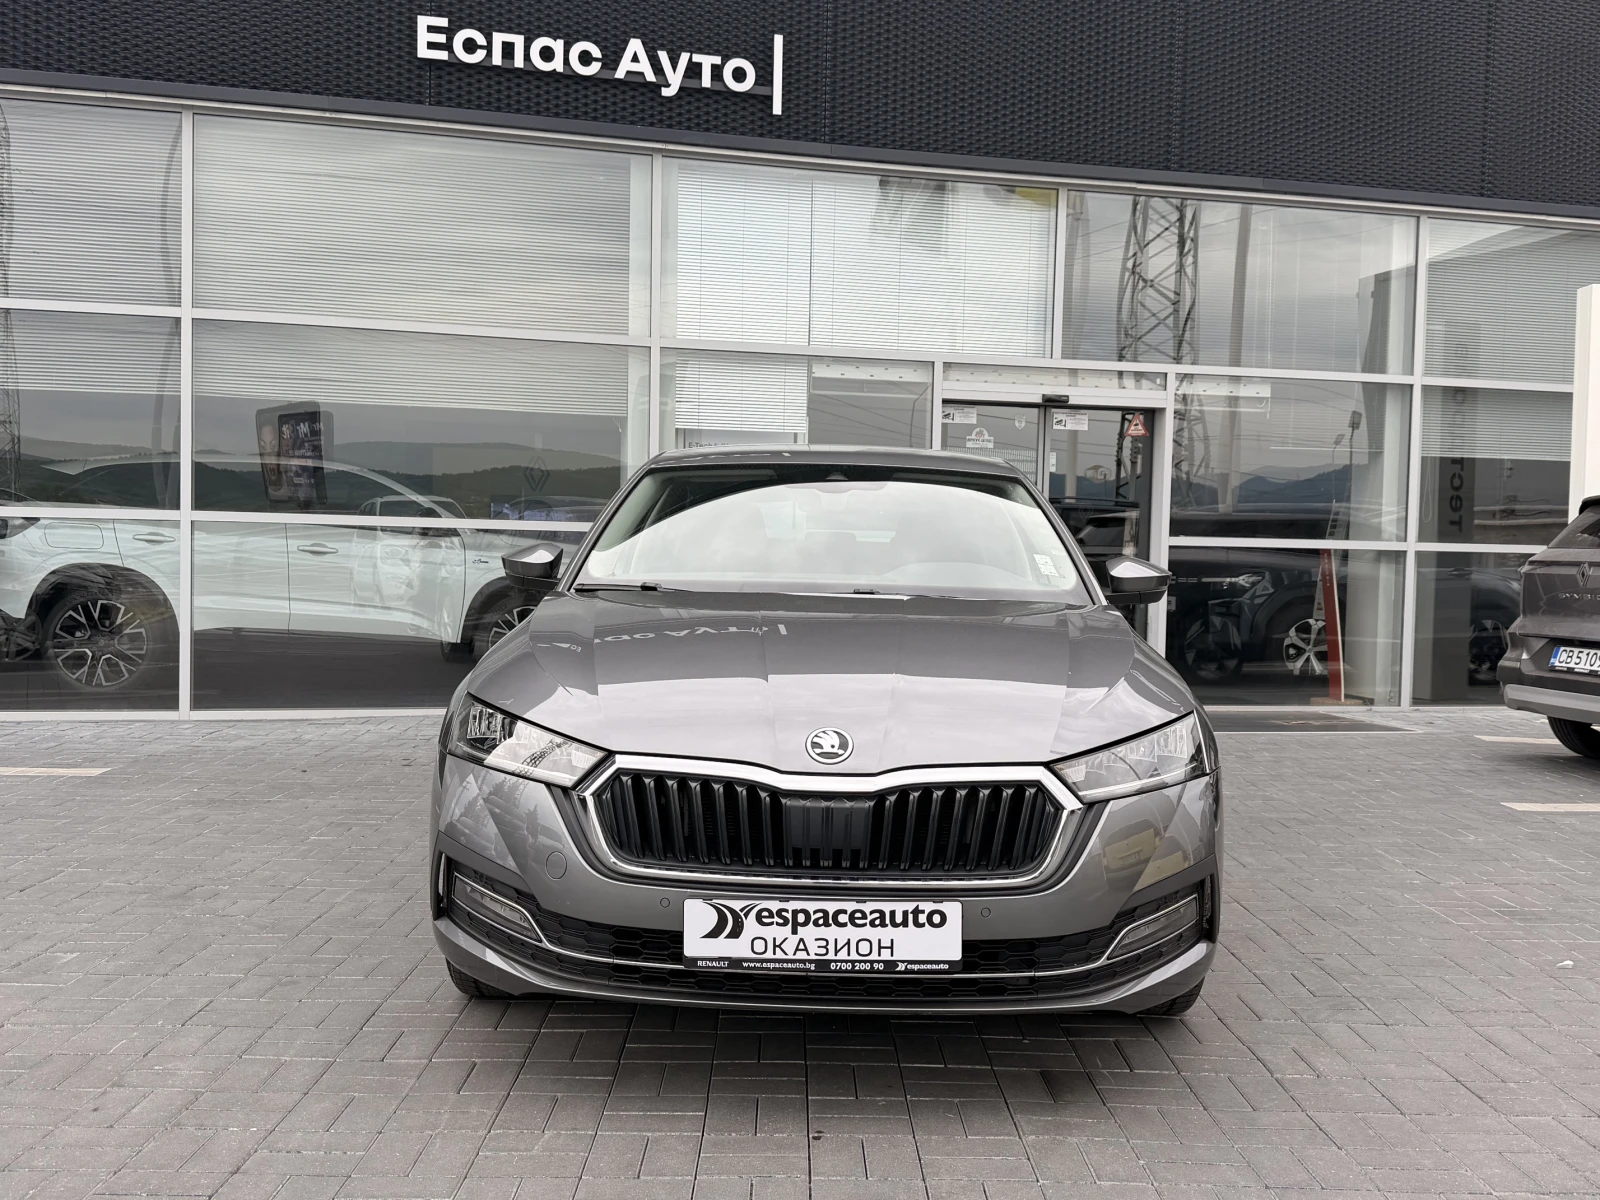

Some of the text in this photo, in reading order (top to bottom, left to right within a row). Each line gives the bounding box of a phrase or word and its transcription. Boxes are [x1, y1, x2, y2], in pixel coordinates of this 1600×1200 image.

[416, 14, 757, 97] Еспас Ауто
[754, 903, 948, 936] espaceauto
[750, 936, 895, 958] ОКАЗИОН
[742, 961, 816, 970] www.espaceauto.bg
[830, 962, 852, 970] 0700
[854, 962, 871, 970] 200
[873, 962, 884, 971] 90
[907, 962, 949, 971] espaceauto
